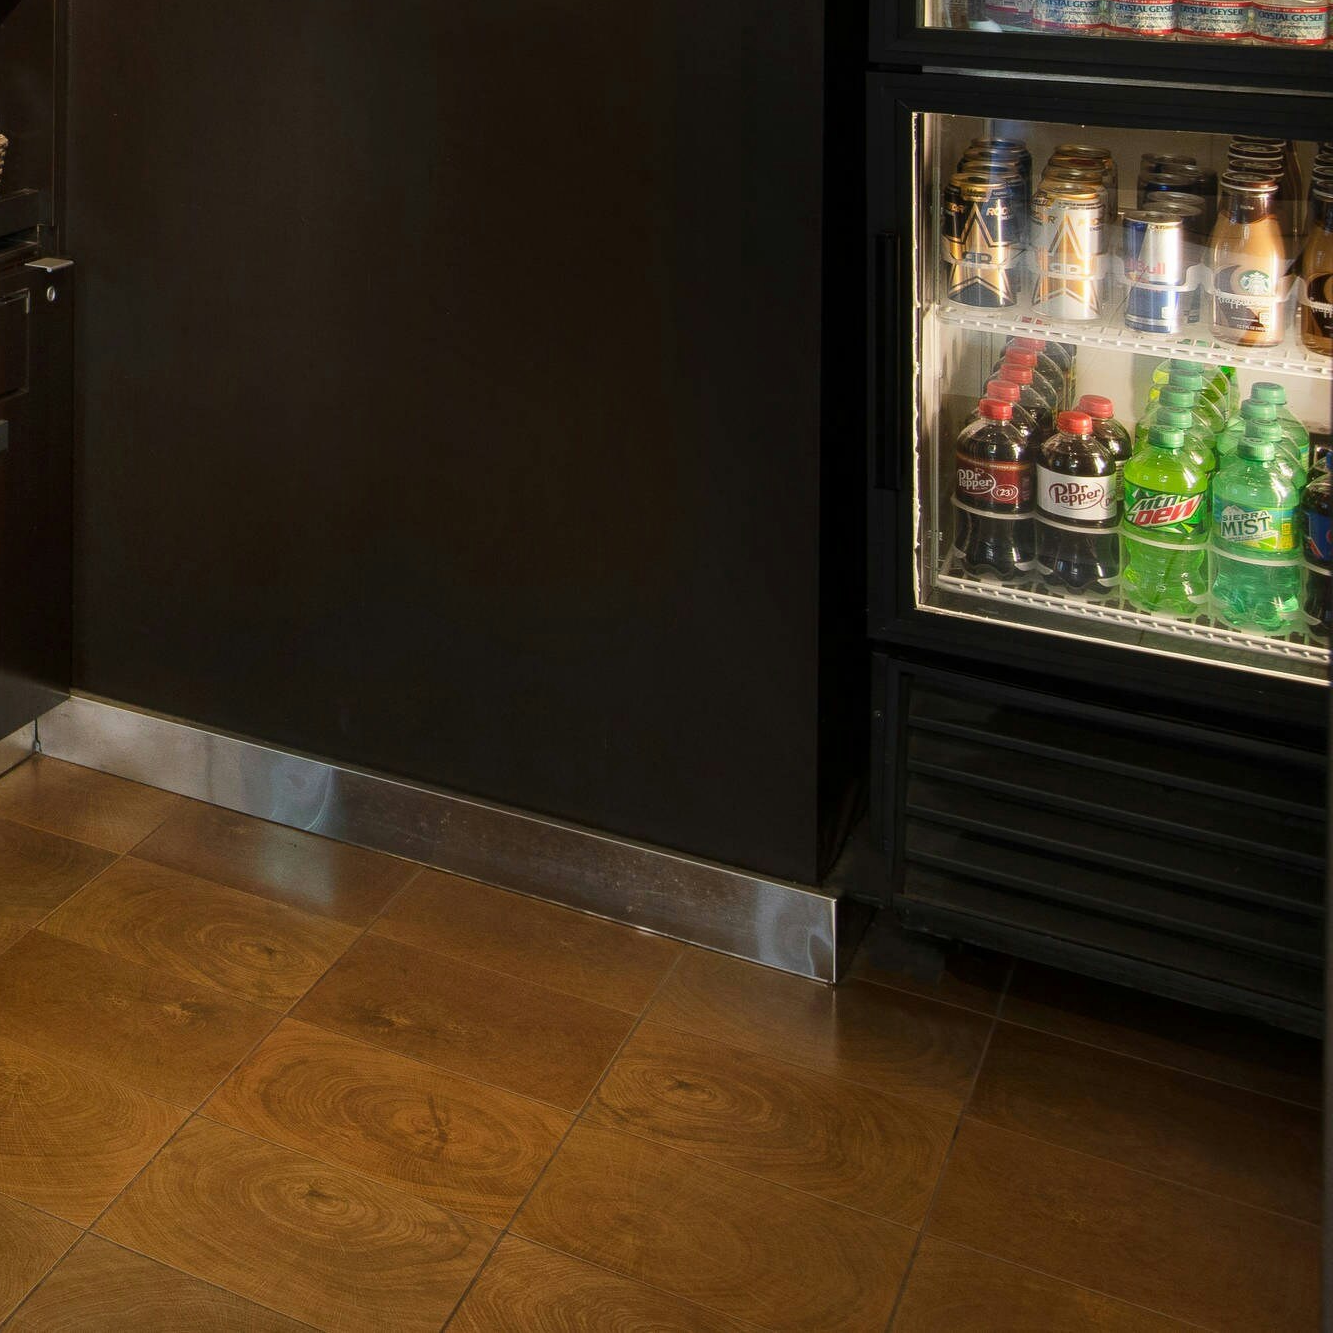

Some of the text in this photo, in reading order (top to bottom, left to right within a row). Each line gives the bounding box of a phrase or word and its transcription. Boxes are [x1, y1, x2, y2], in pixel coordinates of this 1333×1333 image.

[1115, 2, 1148, 13] CRYSTAL
[1210, 7, 1244, 16] GEYSER
[1290, 13, 1324, 22] GEYSER
[958, 469, 994, 490] Pepper
[1068, 482, 1089, 494] Dr
[1053, 483, 1102, 507] Pepper
[1221, 510, 1269, 522] SIERRA
[1220, 516, 1271, 538] MIST
